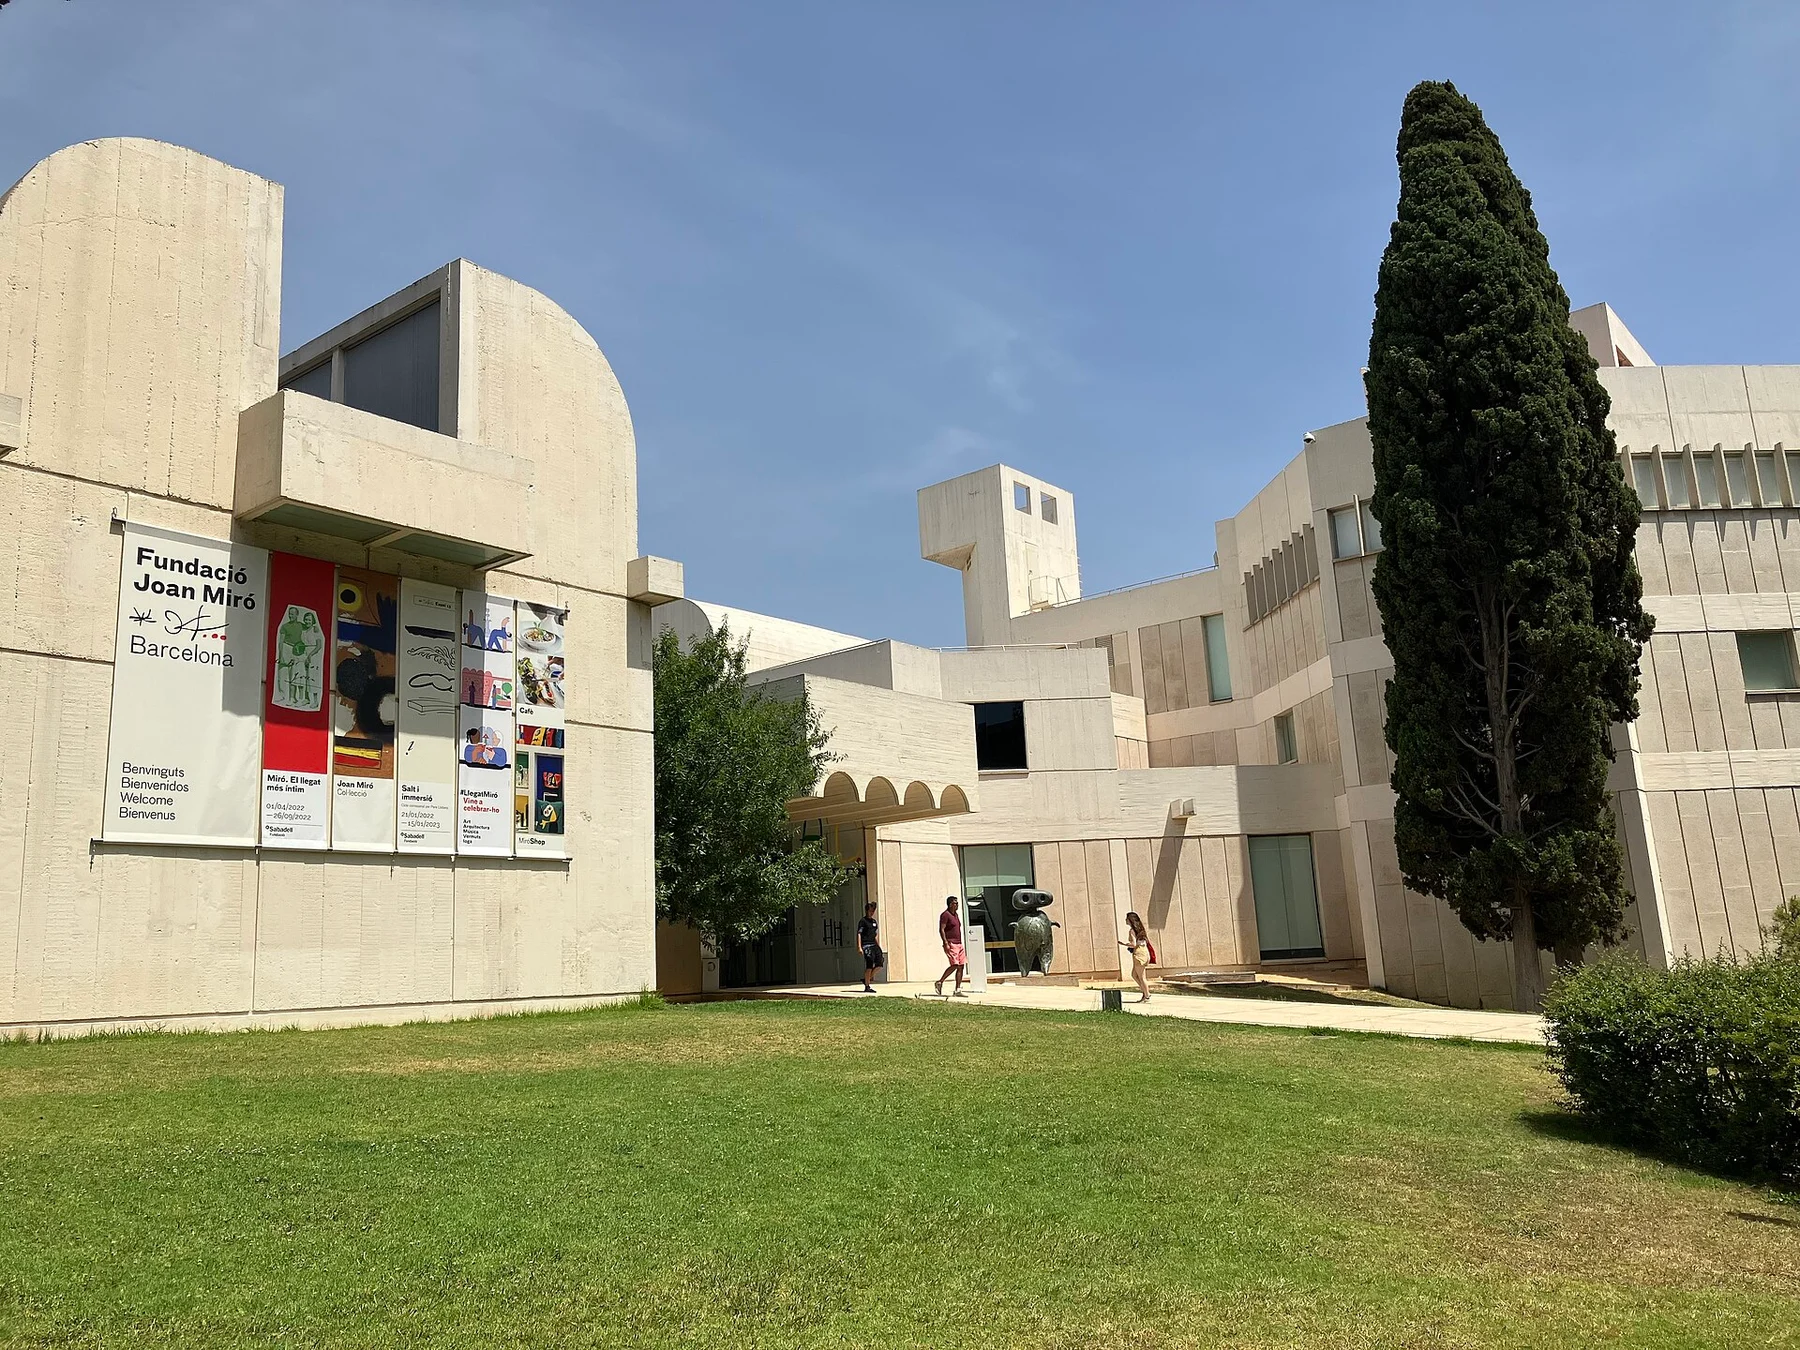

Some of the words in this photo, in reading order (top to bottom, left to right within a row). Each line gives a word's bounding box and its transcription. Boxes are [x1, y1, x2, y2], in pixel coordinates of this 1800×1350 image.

[136, 546, 248, 585] Fundació
[133, 573, 195, 600] Joan
[203, 584, 256, 610] Miró
[130, 634, 234, 667] Barcelona
[122, 761, 185, 779] Benvinguts
[121, 776, 189, 793] Bienvenidos
[267, 774, 289, 783] Miró.
[290, 775, 299, 784] El
[300, 776, 321, 787] llegat
[336, 779, 355, 788] Joan
[356, 781, 374, 790] Miró
[266, 784, 284, 792] més
[285, 784, 305, 793] íntim
[401, 784, 416, 793] Salt
[460, 789, 499, 799] #LlegatMiró
[119, 791, 174, 806] Welcome
[401, 793, 433, 802] immersió
[463, 797, 478, 805] Vine
[265, 802, 305, 811] 01/04/2022
[463, 804, 500, 814] celebrar-ho
[119, 806, 176, 821] Bienvenus
[401, 811, 435, 819] 21/01/2022
